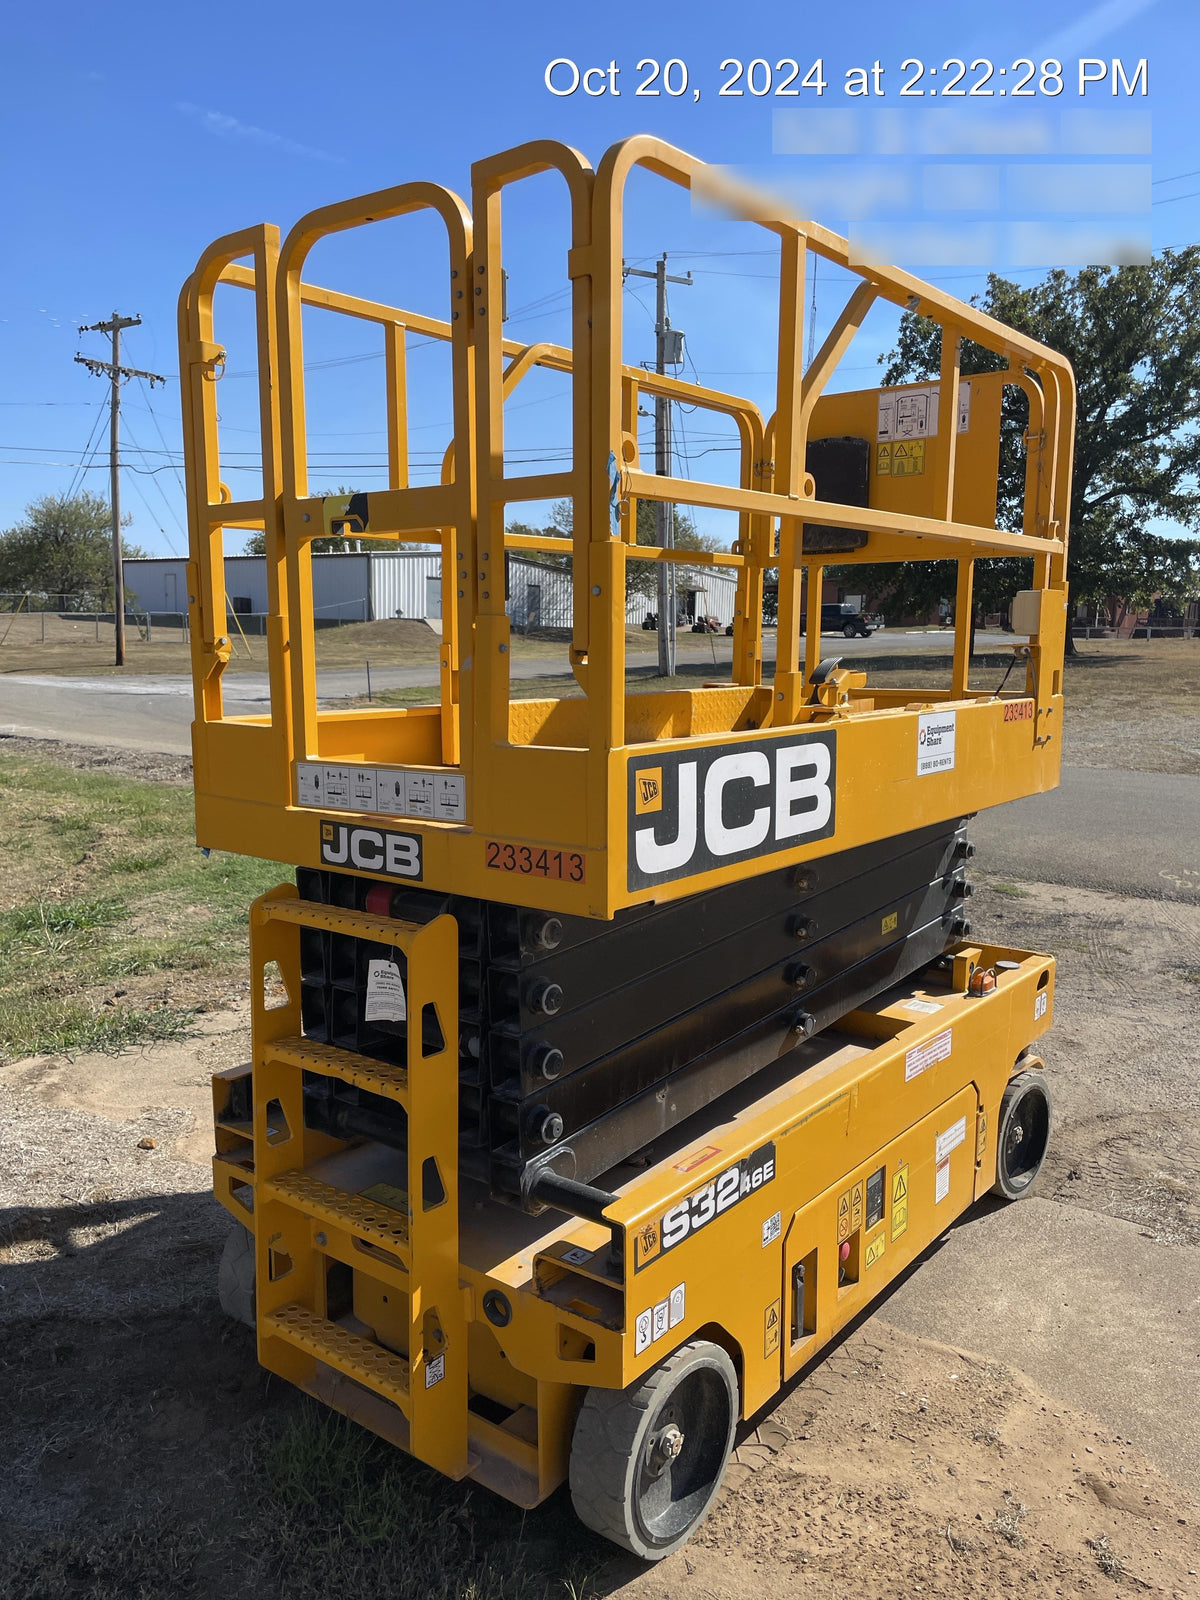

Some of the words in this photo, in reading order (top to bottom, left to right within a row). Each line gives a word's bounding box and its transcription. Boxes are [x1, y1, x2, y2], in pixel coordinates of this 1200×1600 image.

[1004, 702, 1032, 721] 233413
[926, 723, 954, 736] Equipment
[926, 736, 942, 747] Share
[642, 780, 659, 802] JCB
[636, 742, 832, 875] JCB
[322, 826, 420, 877] JCB
[487, 841, 584, 882] 233413
[643, 1232, 657, 1253] JCB
